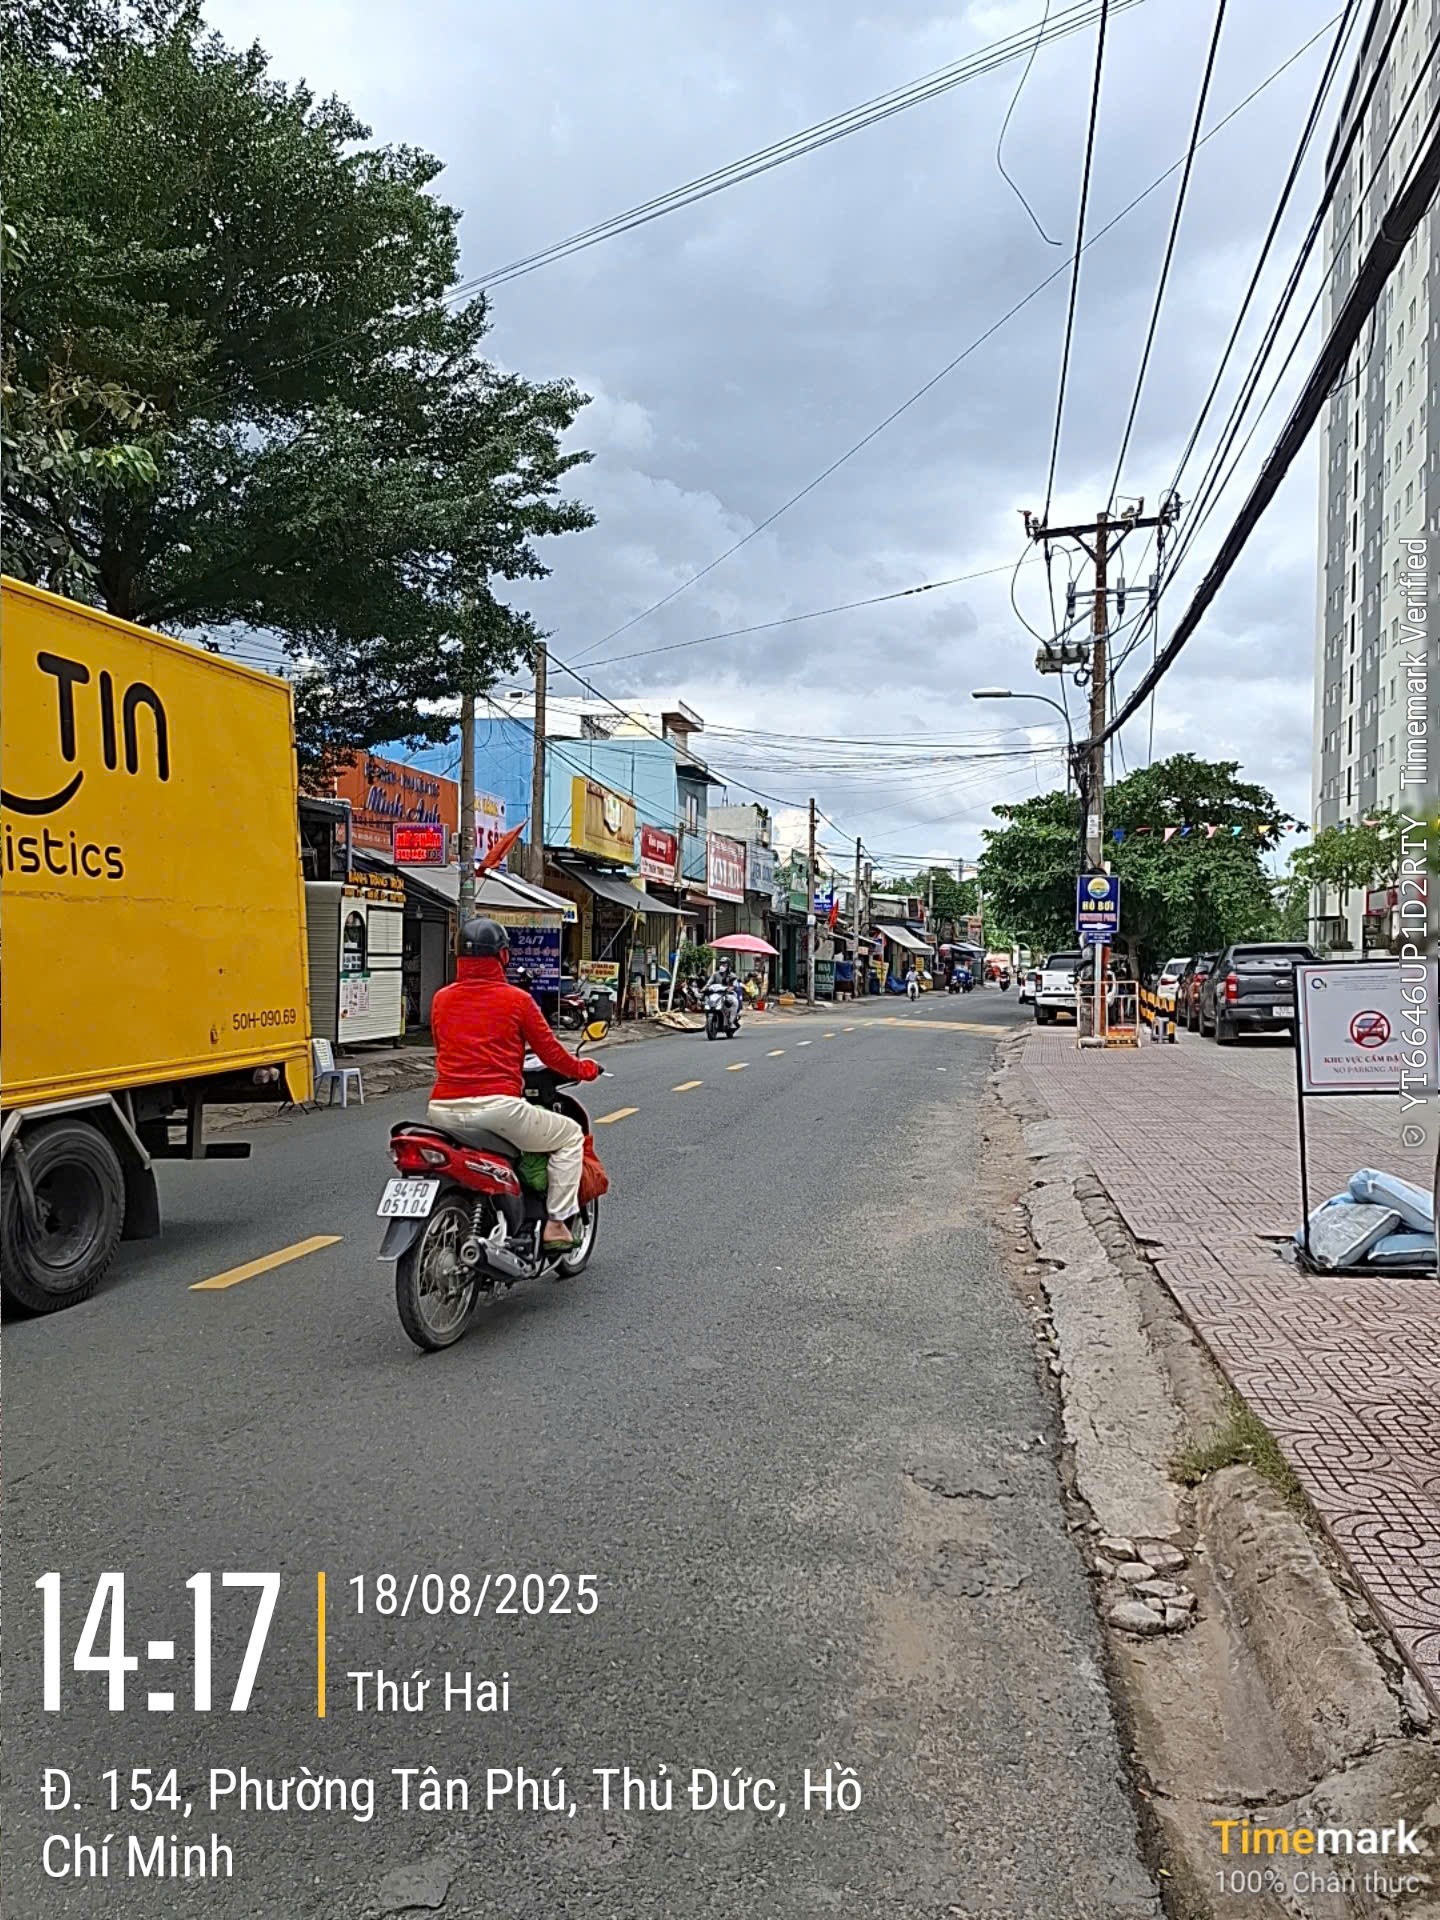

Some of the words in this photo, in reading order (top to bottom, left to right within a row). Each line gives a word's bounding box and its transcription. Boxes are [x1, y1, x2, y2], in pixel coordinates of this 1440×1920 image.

[2, 825, 125, 879] istics
[518, 935, 544, 945] 24/7
[233, 1008, 297, 1031] 50H-090.69
[1324, 1056, 1344, 1064] KHU
[1332, 1066, 1346, 1074] NO
[1347, 1066, 1386, 1074] PARKING
[393, 1182, 430, 1198] 94-FD
[382, 1198, 428, 1214] 051.04
